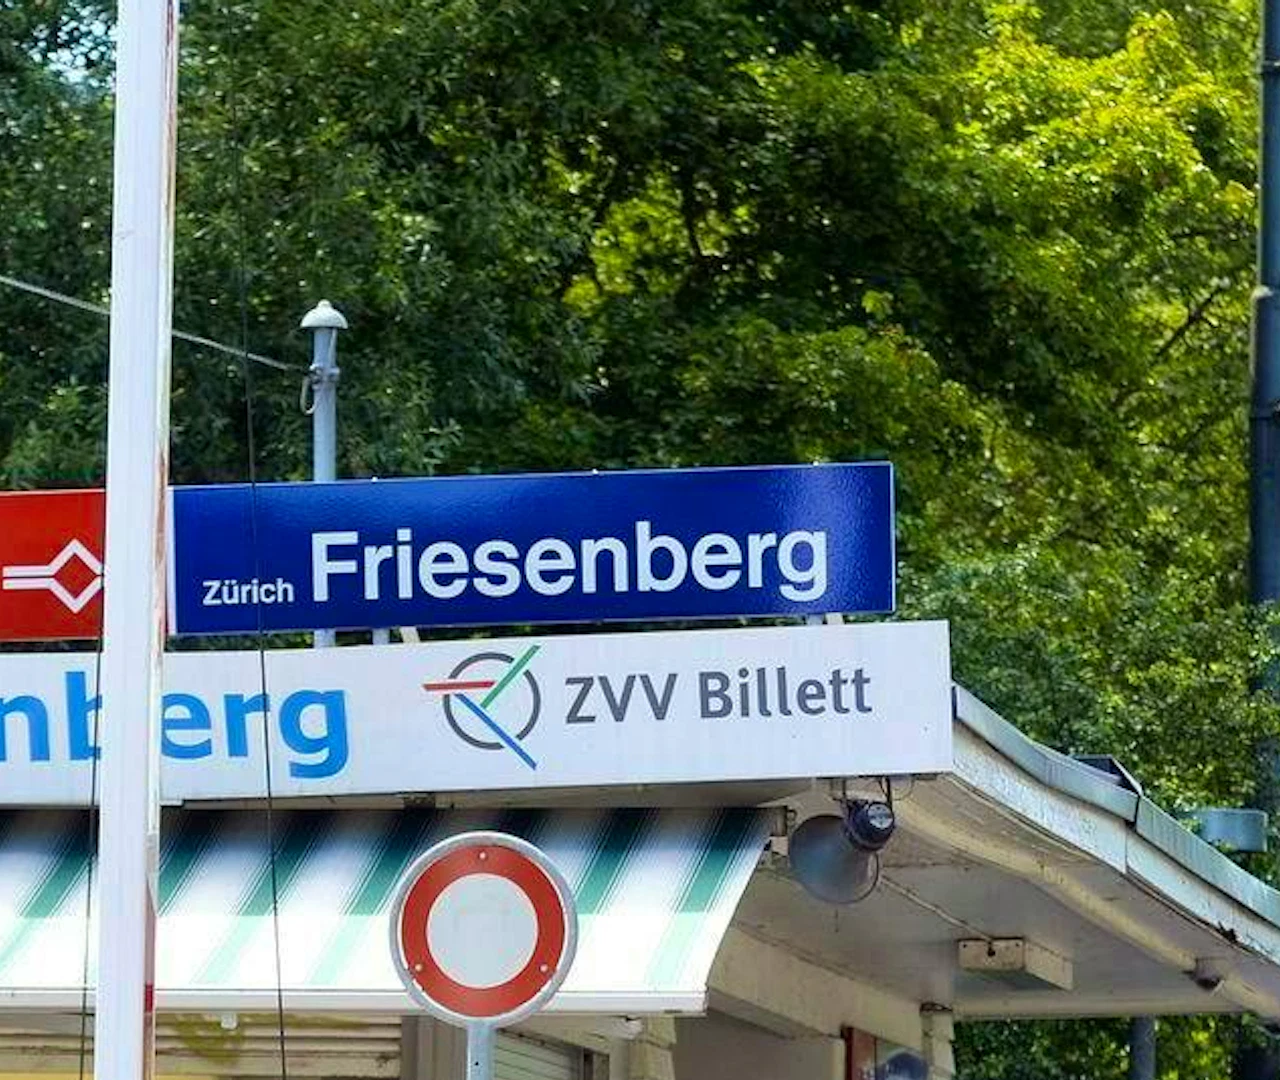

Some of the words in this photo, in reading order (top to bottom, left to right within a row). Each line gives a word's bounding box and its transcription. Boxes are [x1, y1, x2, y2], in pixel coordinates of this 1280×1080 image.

[201, 575, 295, 606] Zürich
[311, 520, 828, 602] Friesenberg
[564, 672, 679, 724] ZVV
[698, 666, 873, 719] Billett
